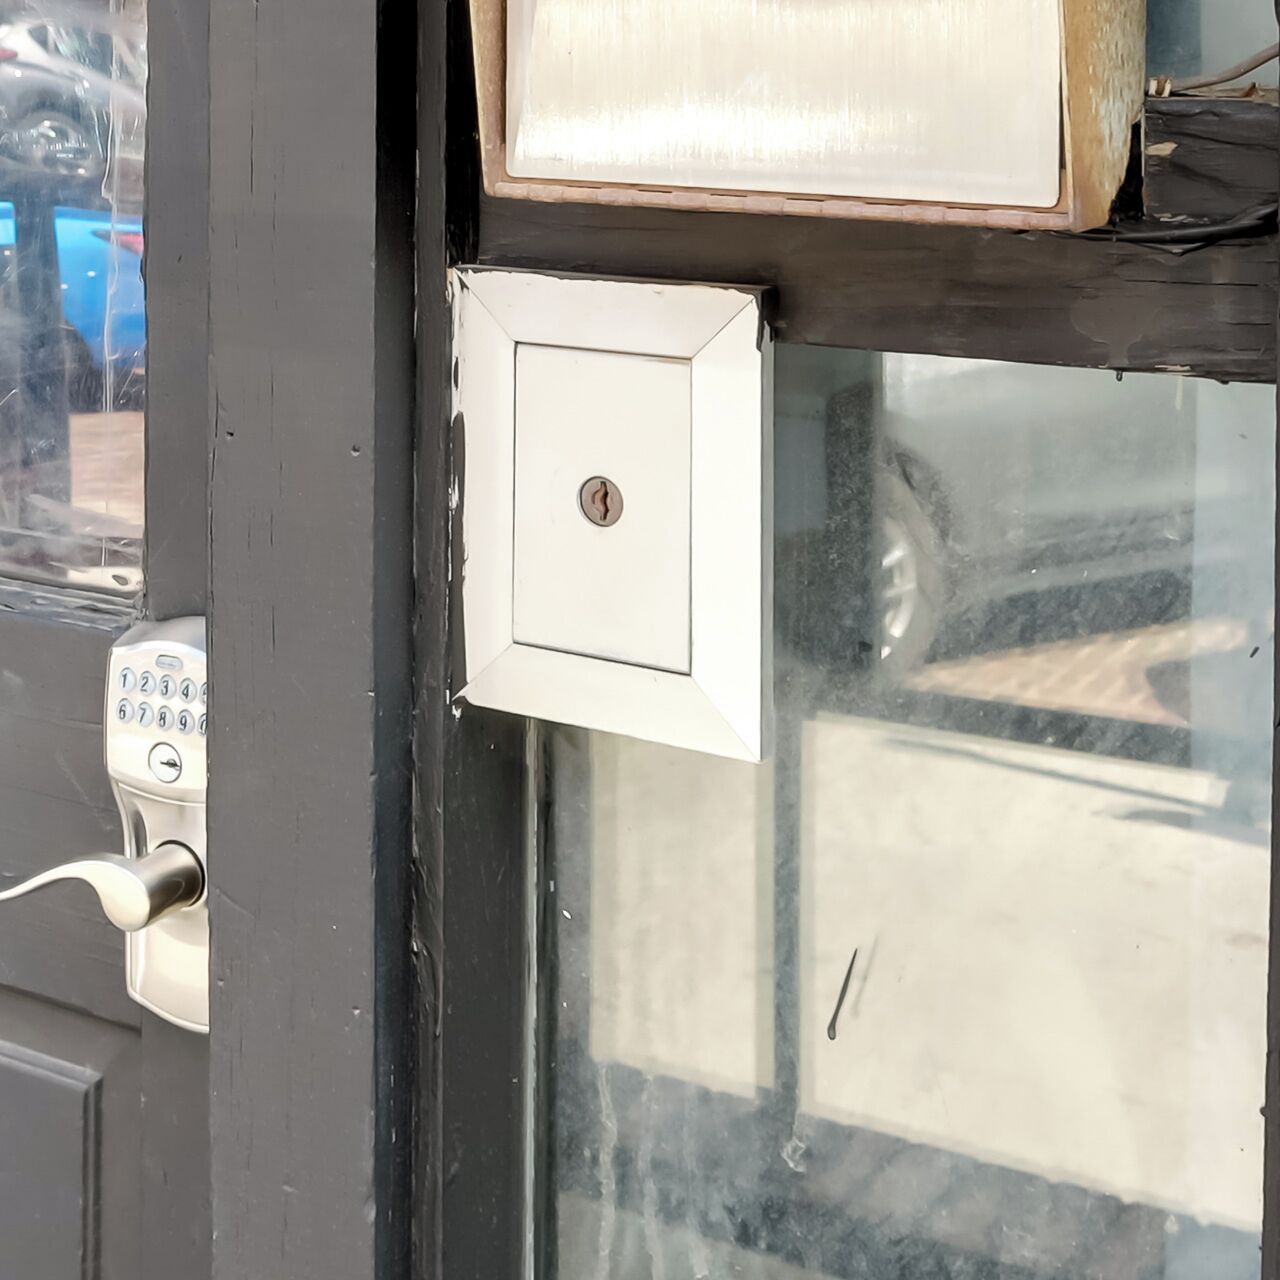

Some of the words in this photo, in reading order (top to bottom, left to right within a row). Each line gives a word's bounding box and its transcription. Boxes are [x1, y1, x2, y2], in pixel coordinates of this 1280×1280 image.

[140, 676, 149, 692] 2
[161, 680, 169, 696] 3
[181, 683, 190, 700] 4
[119, 704, 126, 721] 6
[140, 707, 147, 724] 7
[159, 711, 167, 728] 8
[179, 715, 187, 732] 9
